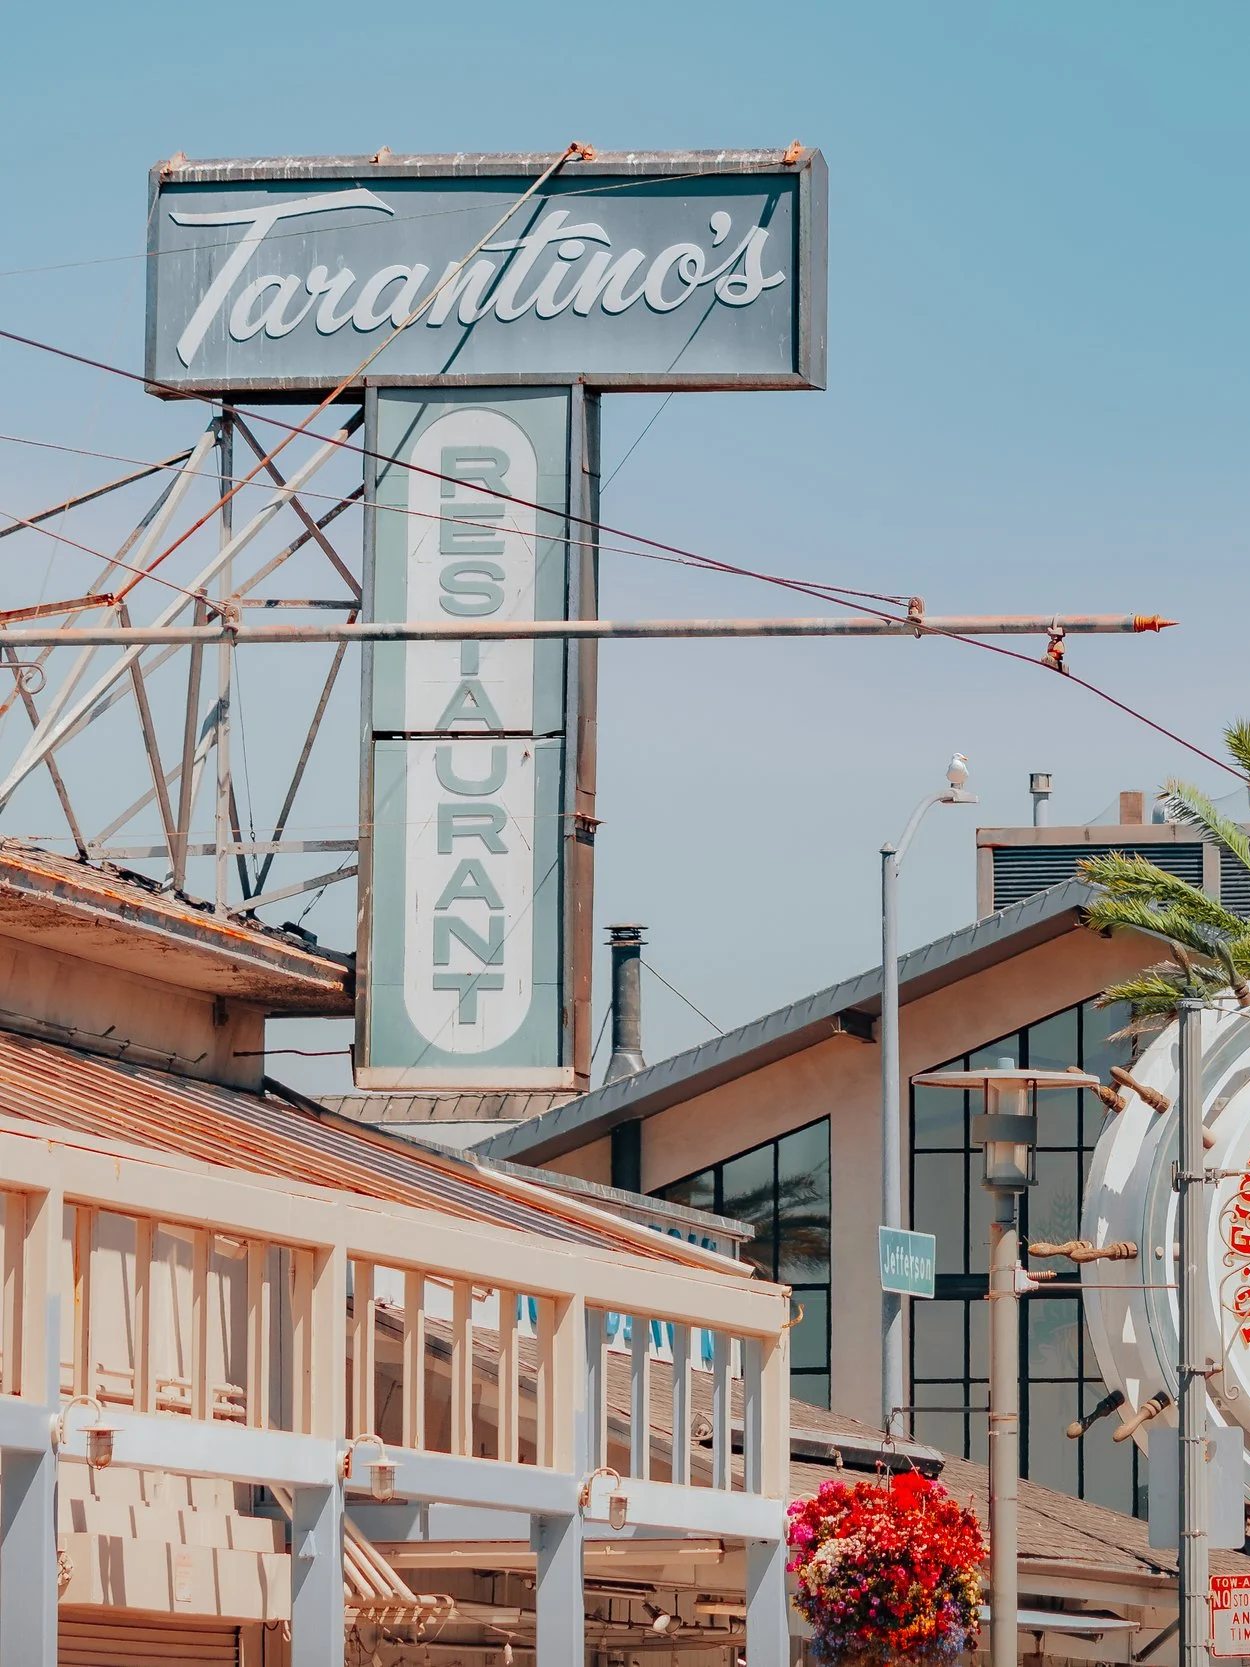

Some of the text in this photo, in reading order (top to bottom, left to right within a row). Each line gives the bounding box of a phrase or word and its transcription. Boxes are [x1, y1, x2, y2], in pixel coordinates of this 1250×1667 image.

[168, 187, 786, 368] Tarantino's
[884, 1243, 932, 1281] Jefferson
[1212, 1589, 1231, 1608] NO
